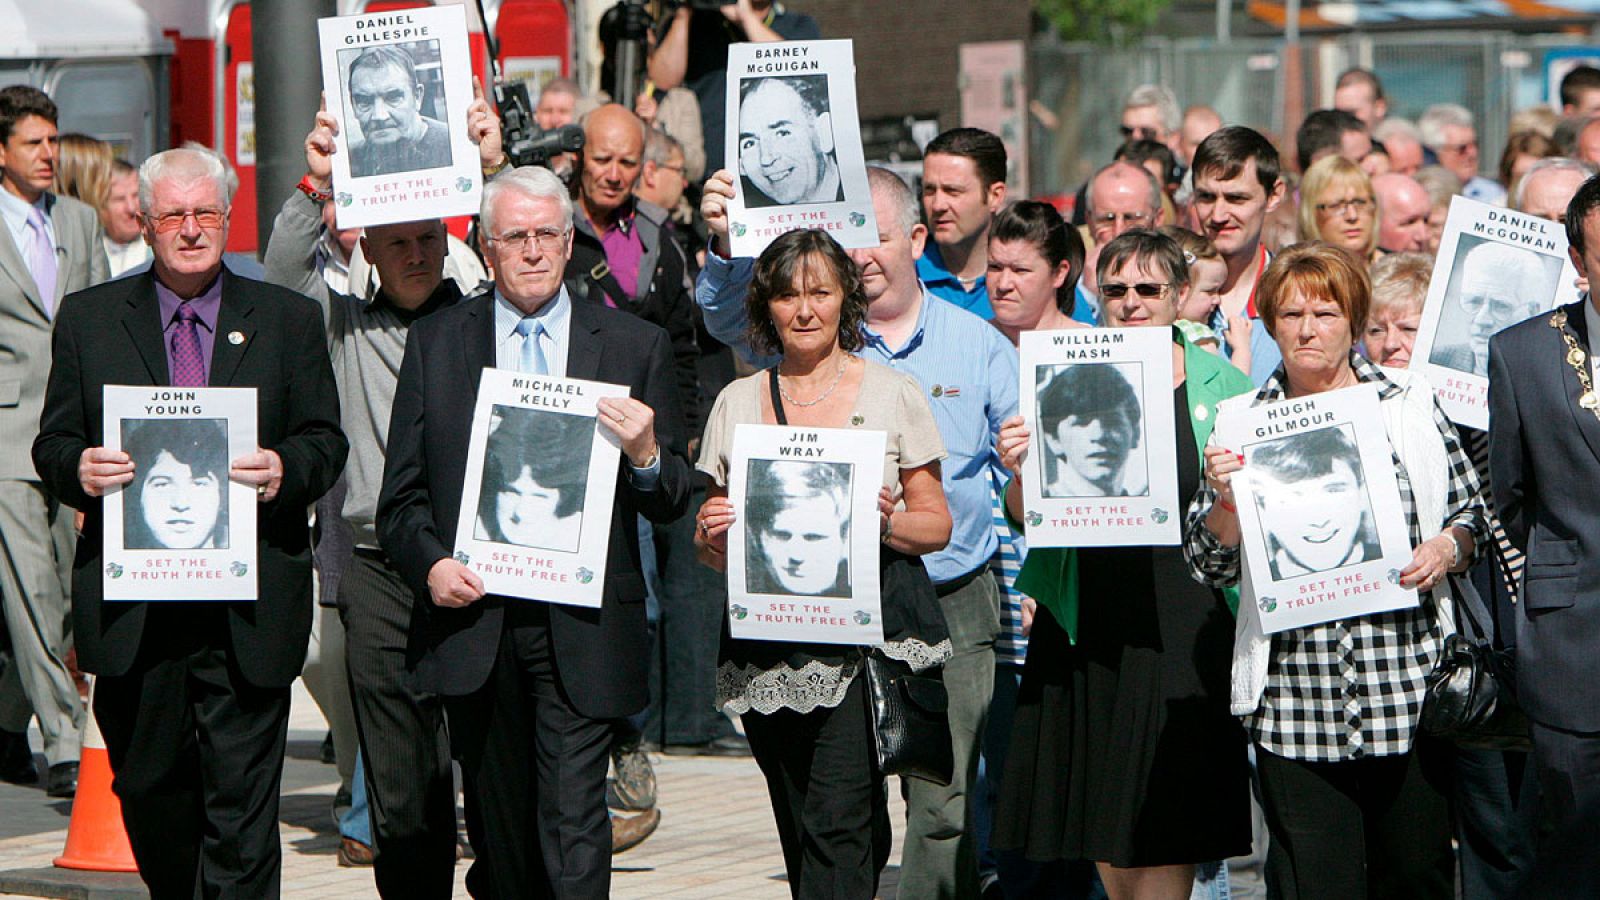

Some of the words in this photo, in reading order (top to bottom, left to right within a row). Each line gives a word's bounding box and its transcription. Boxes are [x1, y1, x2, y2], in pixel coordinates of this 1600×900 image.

[356, 15, 414, 29] DANIEL
[344, 26, 429, 45] GILLESPIE
[755, 47, 809, 59] BARNEY
[747, 60, 819, 73] McGUIGAN
[374, 182, 399, 193] SET
[406, 178, 433, 188] THE
[360, 194, 407, 206] TRUTH
[414, 187, 449, 200] FREE
[769, 213, 795, 224] SET
[800, 211, 827, 221] THE
[1488, 211, 1547, 234] DANIEL
[808, 221, 844, 231] FREE
[1474, 222, 1556, 250] McGOWAN
[1053, 333, 1124, 345] WILLIAM
[1067, 348, 1110, 359] NASH
[512, 378, 584, 396] MICHAEL
[1446, 378, 1472, 391] SET
[151, 391, 196, 401] JOHN
[520, 394, 570, 409] KELLY
[1437, 388, 1476, 406] RUTH
[144, 405, 202, 415] YOUNG
[1267, 400, 1316, 420] HUGH
[1255, 411, 1335, 437] GILMOUR
[789, 432, 818, 443] JIM
[779, 446, 825, 457] WRAY
[1066, 506, 1093, 516] SET
[1100, 505, 1129, 514] THE
[1050, 518, 1100, 528] TRUTH
[1107, 517, 1145, 526] FREE
[146, 559, 172, 568] SET
[180, 558, 207, 567] THE
[491, 552, 518, 563] SET
[526, 556, 554, 568] THE
[131, 571, 179, 580] TRUTH
[187, 570, 223, 579] FREE
[475, 563, 524, 577] TRUTH
[531, 570, 568, 582] FREE
[1299, 581, 1326, 594] SET
[1334, 573, 1364, 585] THE
[1286, 592, 1336, 609] TRUTH
[1343, 581, 1381, 597] FREE
[769, 603, 796, 612] SET
[803, 604, 831, 613] THE
[755, 614, 803, 624] TRUTH
[811, 617, 847, 626] FREE
